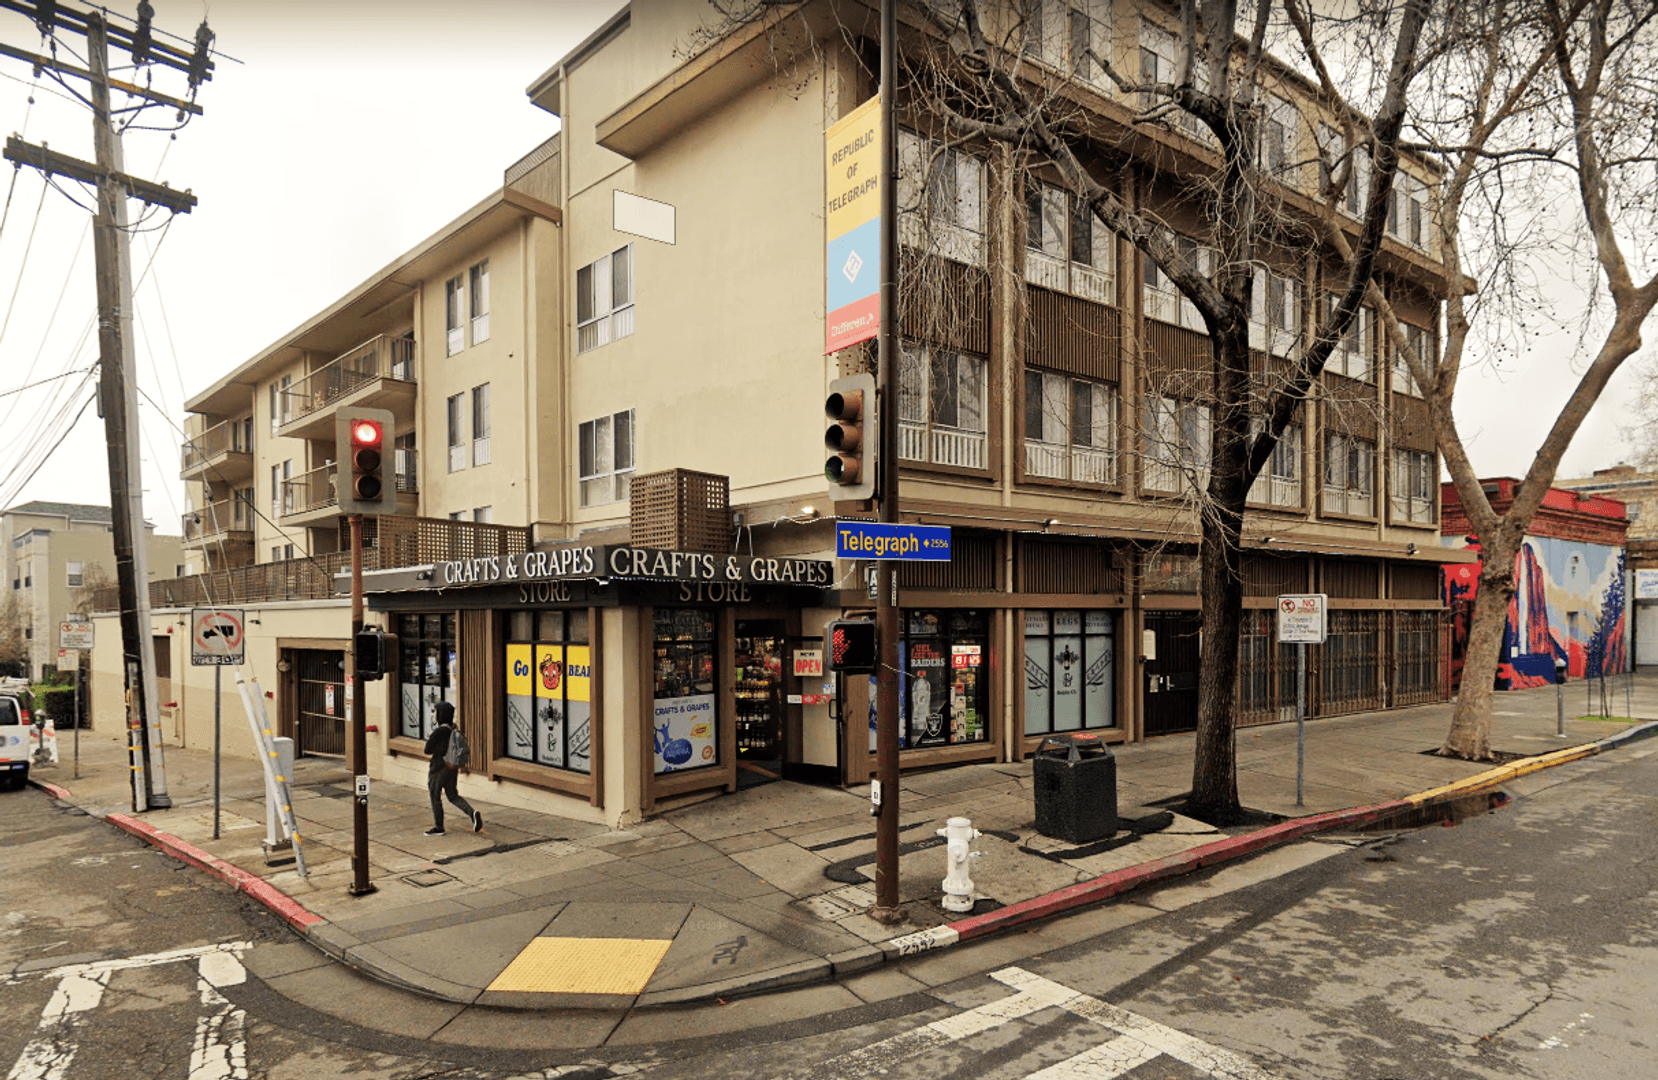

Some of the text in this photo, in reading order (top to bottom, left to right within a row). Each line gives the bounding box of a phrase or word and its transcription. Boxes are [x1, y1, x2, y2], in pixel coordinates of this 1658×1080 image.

[832, 128, 875, 167] REPUBLIC
[846, 162, 859, 180] OF
[828, 174, 878, 214] TELEGRAPH
[839, 530, 920, 557] Telegraph
[444, 546, 595, 585] CRAFTS & GRAPES
[610, 548, 716, 580] CRAFTS
[725, 556, 743, 581] &
[750, 557, 828, 583] GRAPES
[519, 581, 572, 603] STORE
[679, 581, 752, 603] STORE
[1302, 599, 1316, 607] NO
[513, 659, 530, 677] Go
[568, 664, 590, 678] BEA
[795, 659, 821, 674] OPEN
[910, 657, 946, 668] RAIDERS
[655, 705, 679, 716] CRAFTS
[686, 702, 710, 712] GRAPES
